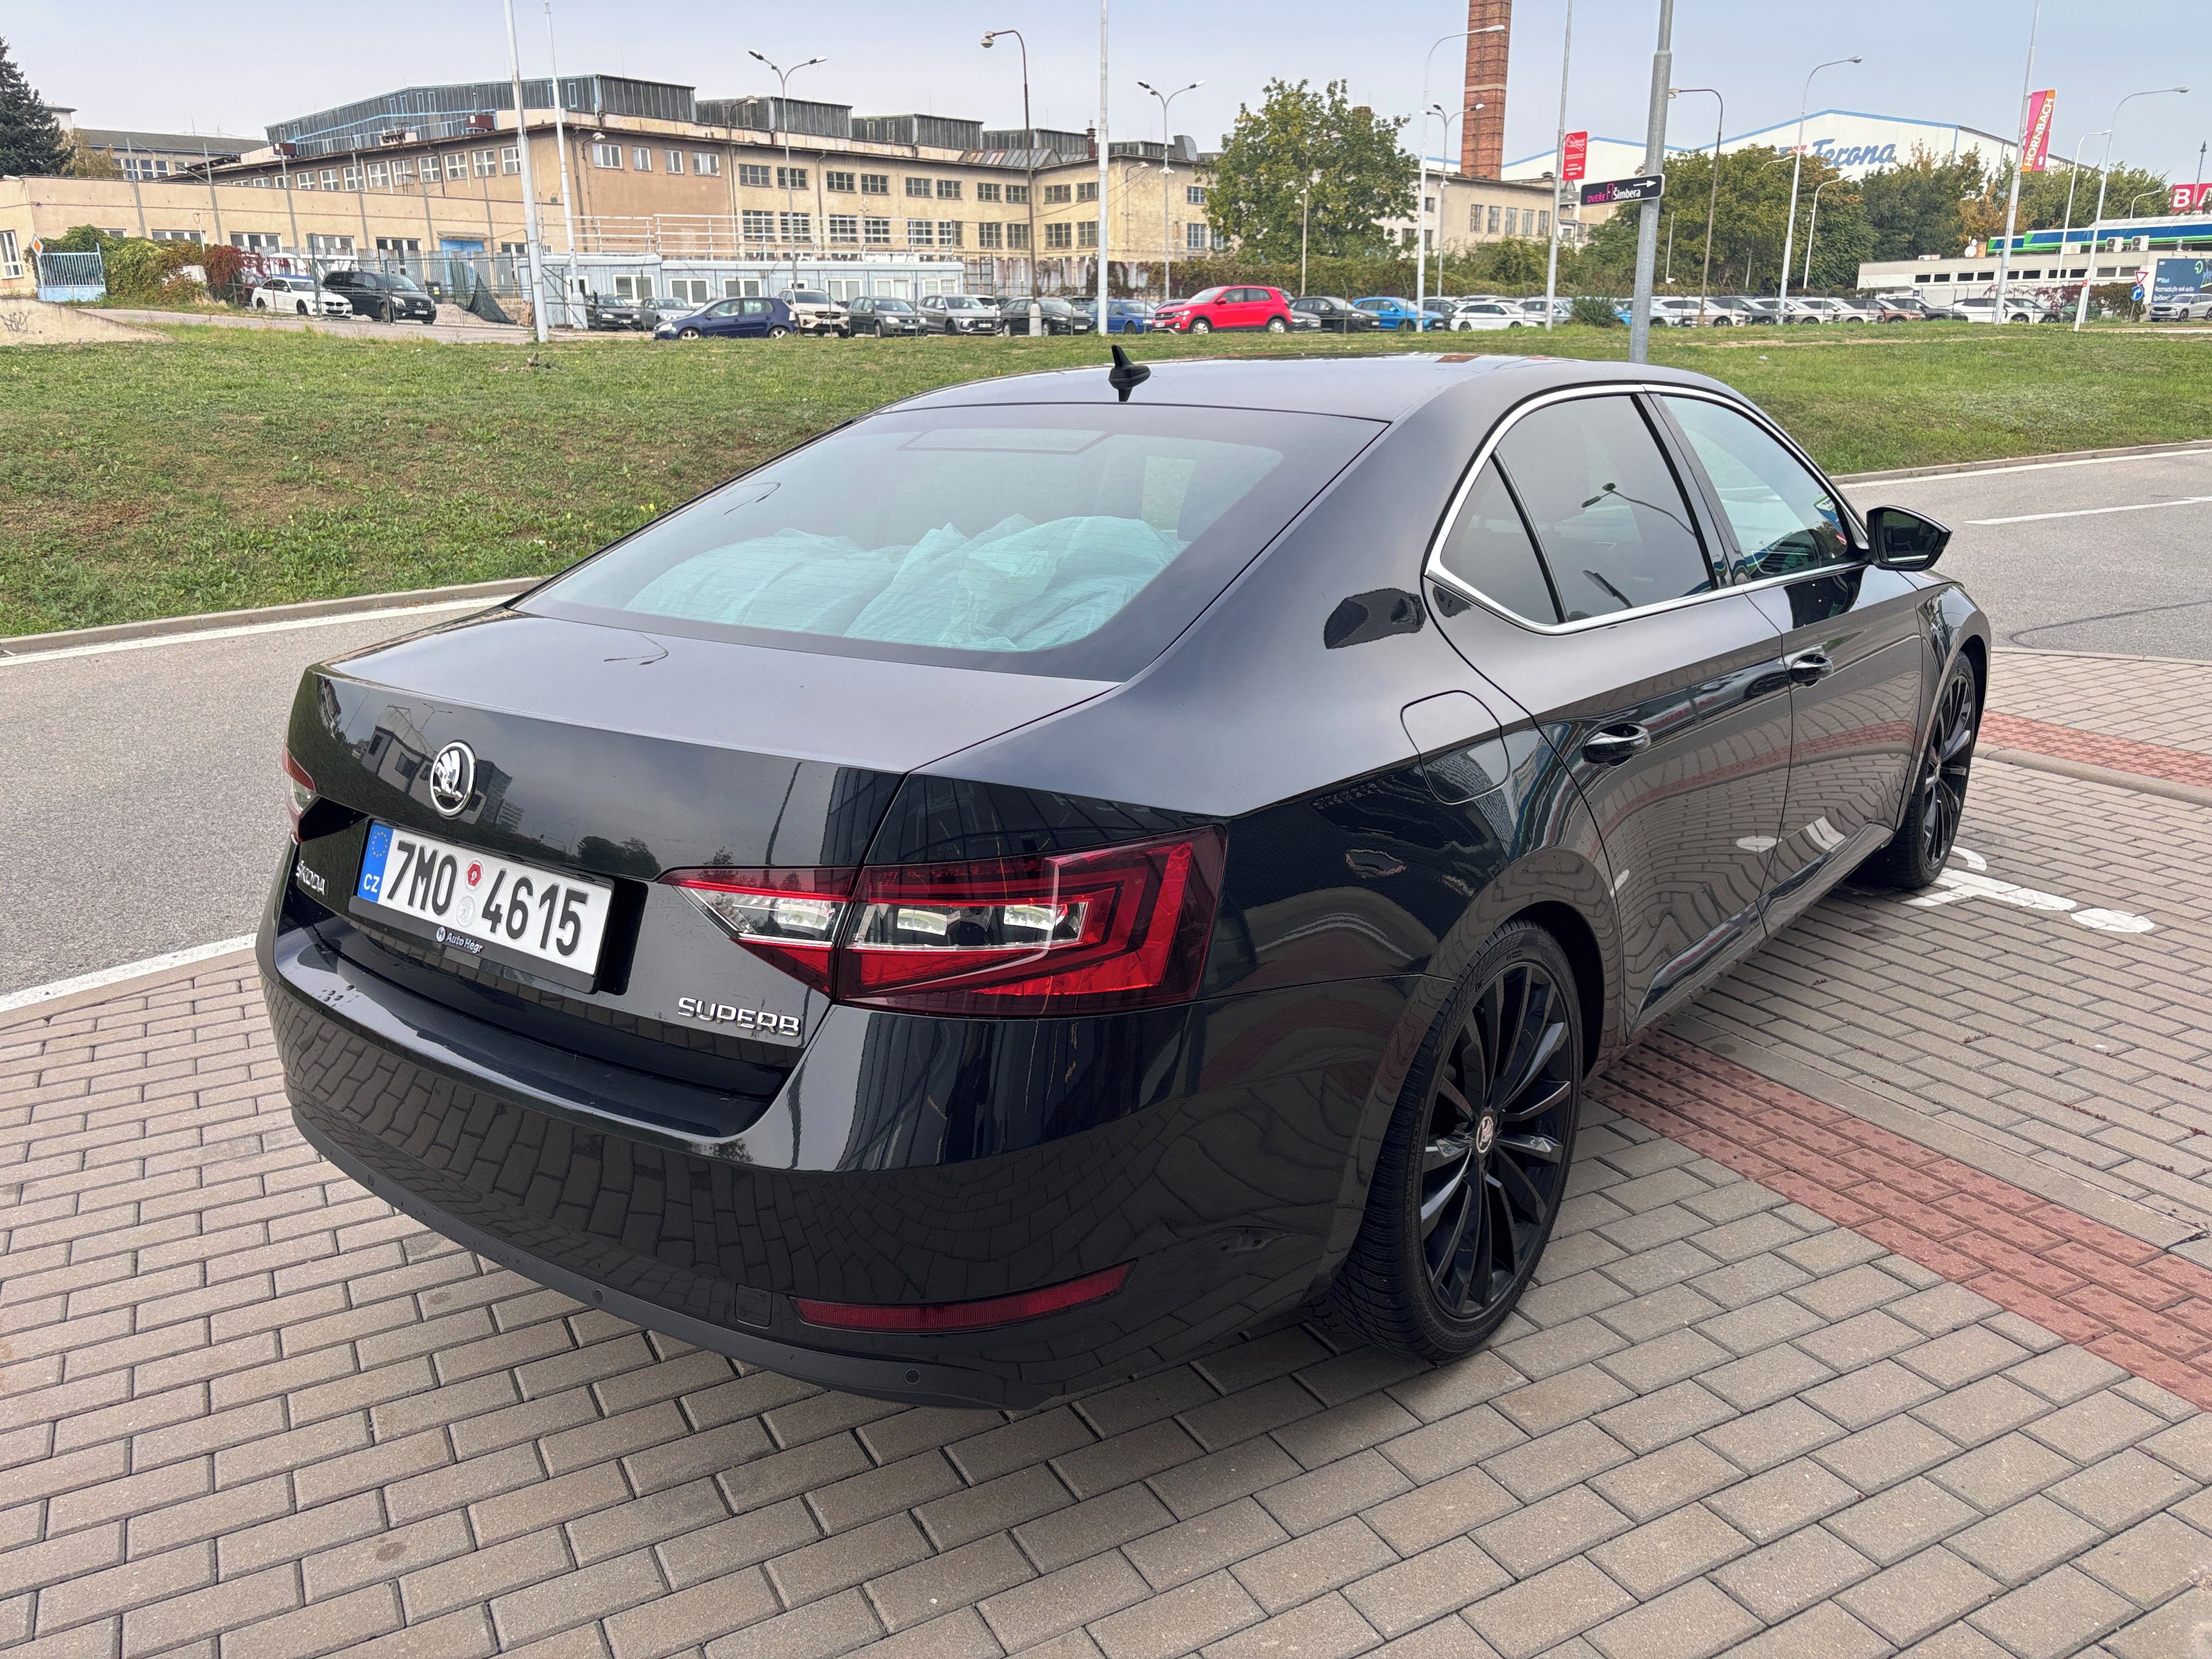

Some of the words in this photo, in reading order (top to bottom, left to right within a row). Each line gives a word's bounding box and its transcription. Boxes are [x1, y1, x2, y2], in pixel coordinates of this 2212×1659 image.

[2024, 98, 2054, 167] HORNBACH
[1613, 187, 1641, 200] Šimbera
[363, 873, 380, 894] CZ
[482, 868, 589, 956] 4615
[445, 933, 464, 946] Auto
[678, 996, 802, 1037] SUPERB
